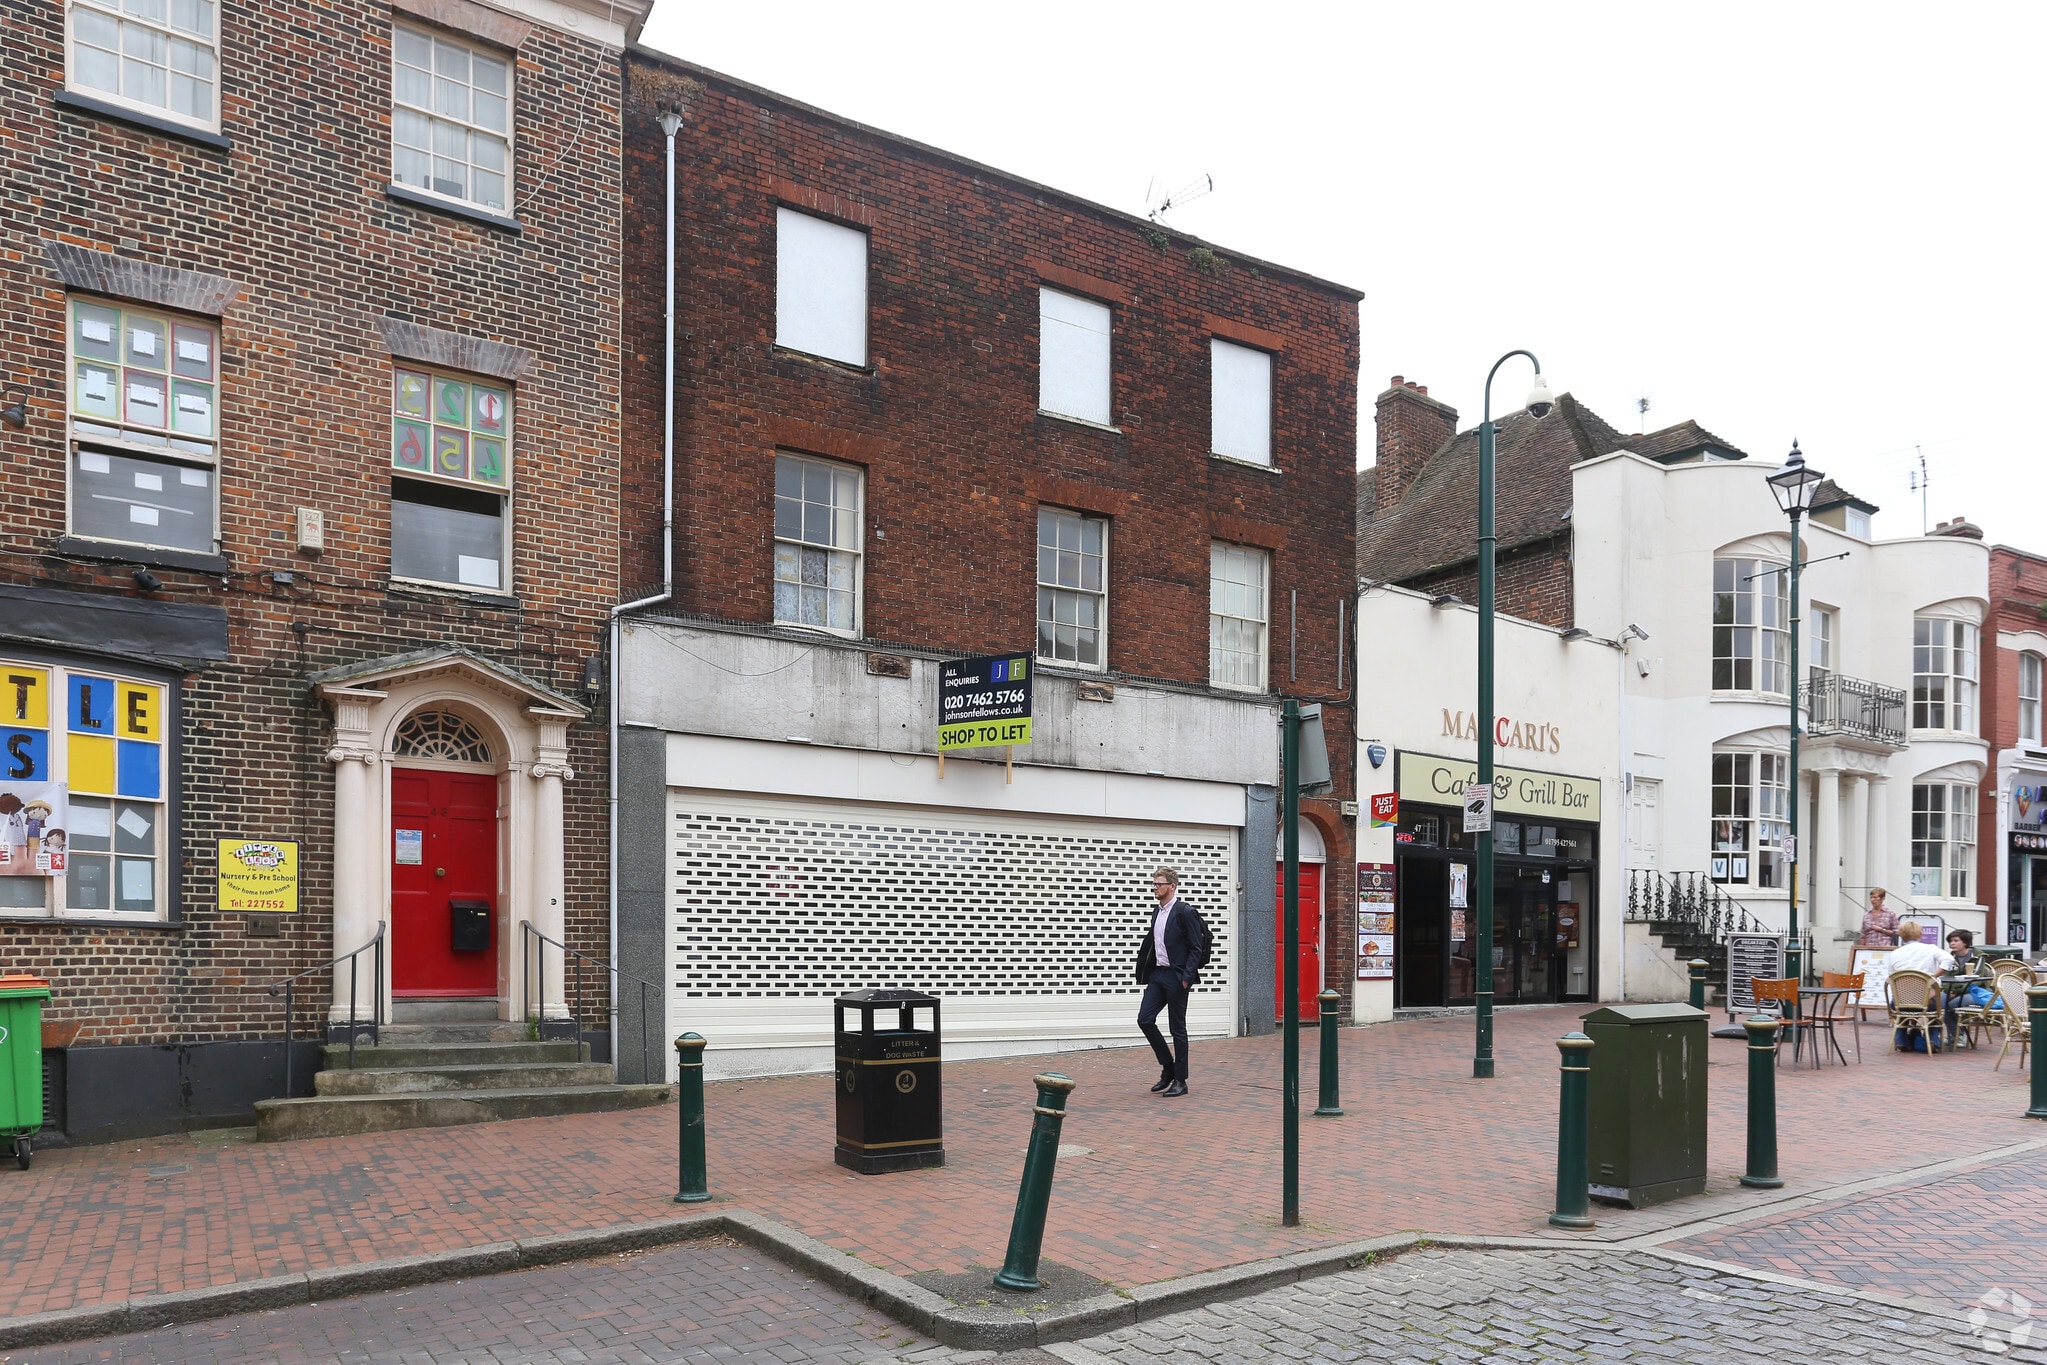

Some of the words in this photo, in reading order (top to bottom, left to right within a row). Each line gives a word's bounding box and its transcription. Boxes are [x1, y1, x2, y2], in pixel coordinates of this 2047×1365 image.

[945, 668, 958, 677] ALL
[945, 675, 980, 687] ENQUIRIES
[944, 695, 964, 710] 020
[966, 692, 993, 707] 7462
[995, 688, 1025, 704] 5766
[944, 704, 1023, 722] johnsonfellows.co.uk
[942, 729, 975, 746] SHOP
[978, 726, 998, 742] TO
[1002, 724, 1026, 741] LET
[1441, 707, 1560, 754] MACARI'S
[1431, 767, 1478, 796] Caf
[1519, 778, 1557, 805] Grill
[1561, 782, 1590, 809] Bar
[1374, 796, 1394, 808] JUST
[1378, 804, 1394, 814] EAT
[1414, 823, 1422, 832] 47
[2014, 822, 2041, 831] BARBER
[237, 843, 284, 858] LITTLE
[246, 857, 277, 865] LEGS
[220, 872, 250, 880] Nursery
[272, 874, 296, 882] School
[274, 884, 291, 894] home
[230, 899, 245, 908] Tel:
[247, 899, 285, 909] 227552
[901, 1050, 925, 1058] WASTE
